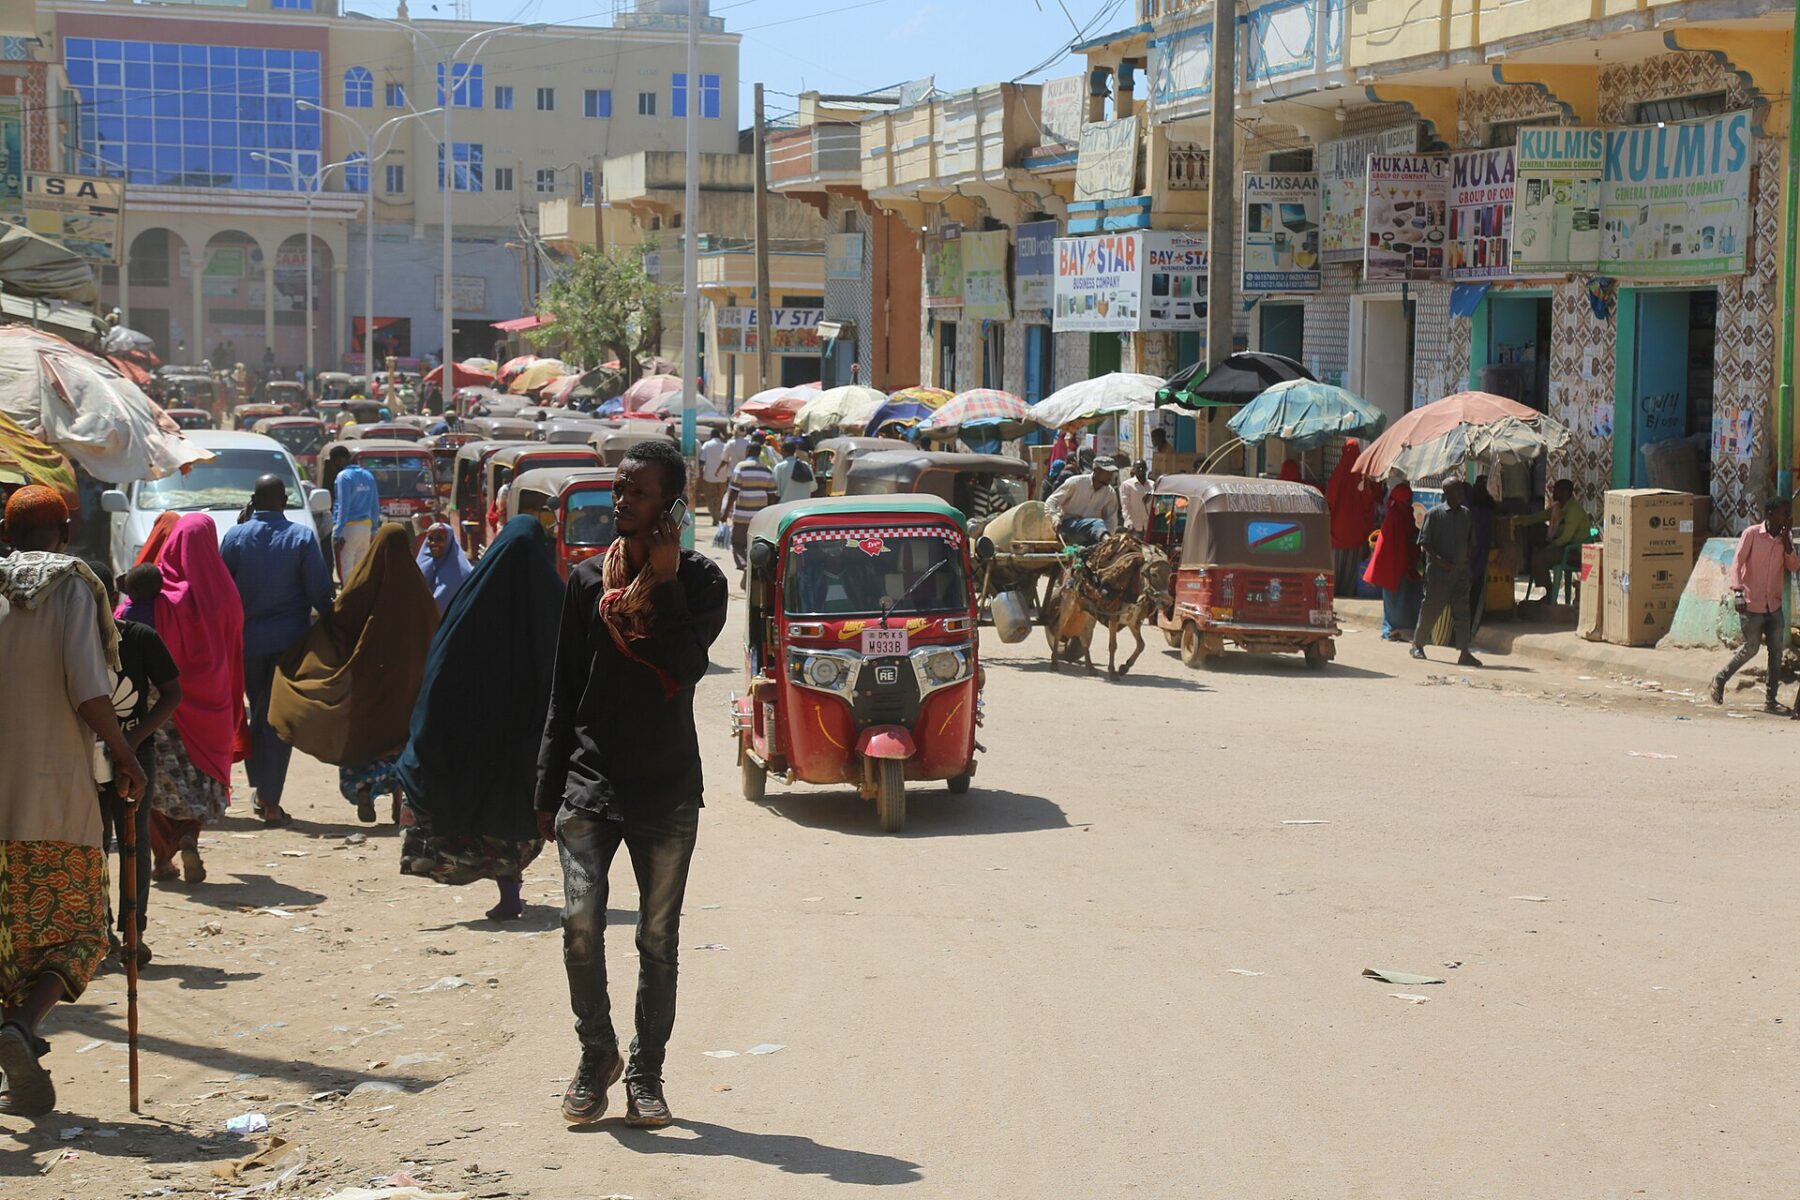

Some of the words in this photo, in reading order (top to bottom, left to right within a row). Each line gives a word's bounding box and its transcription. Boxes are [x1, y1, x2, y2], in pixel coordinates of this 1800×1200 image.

[1521, 131, 1602, 160] KULMIS
[1605, 115, 1746, 182] KULMIS
[1371, 157, 1430, 173] MUKALA
[1520, 160, 1545, 168] GENERAL
[1547, 160, 1572, 168] TRADING
[1574, 160, 1601, 168] COMPANY
[1248, 177, 1319, 190] AL-IXSAAN
[1615, 186, 1647, 201] GENERAL
[1650, 183, 1684, 199] TRADING
[1686, 180, 1726, 197] COMPANY
[1459, 190, 1485, 204] GROUP
[1487, 189, 1498, 201] OF
[1060, 240, 1086, 276] BAY
[1097, 236, 1135, 273] STAR
[1150, 250, 1173, 265] BAY
[1073, 277, 1095, 290] BUSINESS
[1096, 276, 1120, 289] COMPANY
[1663, 517, 1676, 527] LG
[880, 672, 894, 681] RE
